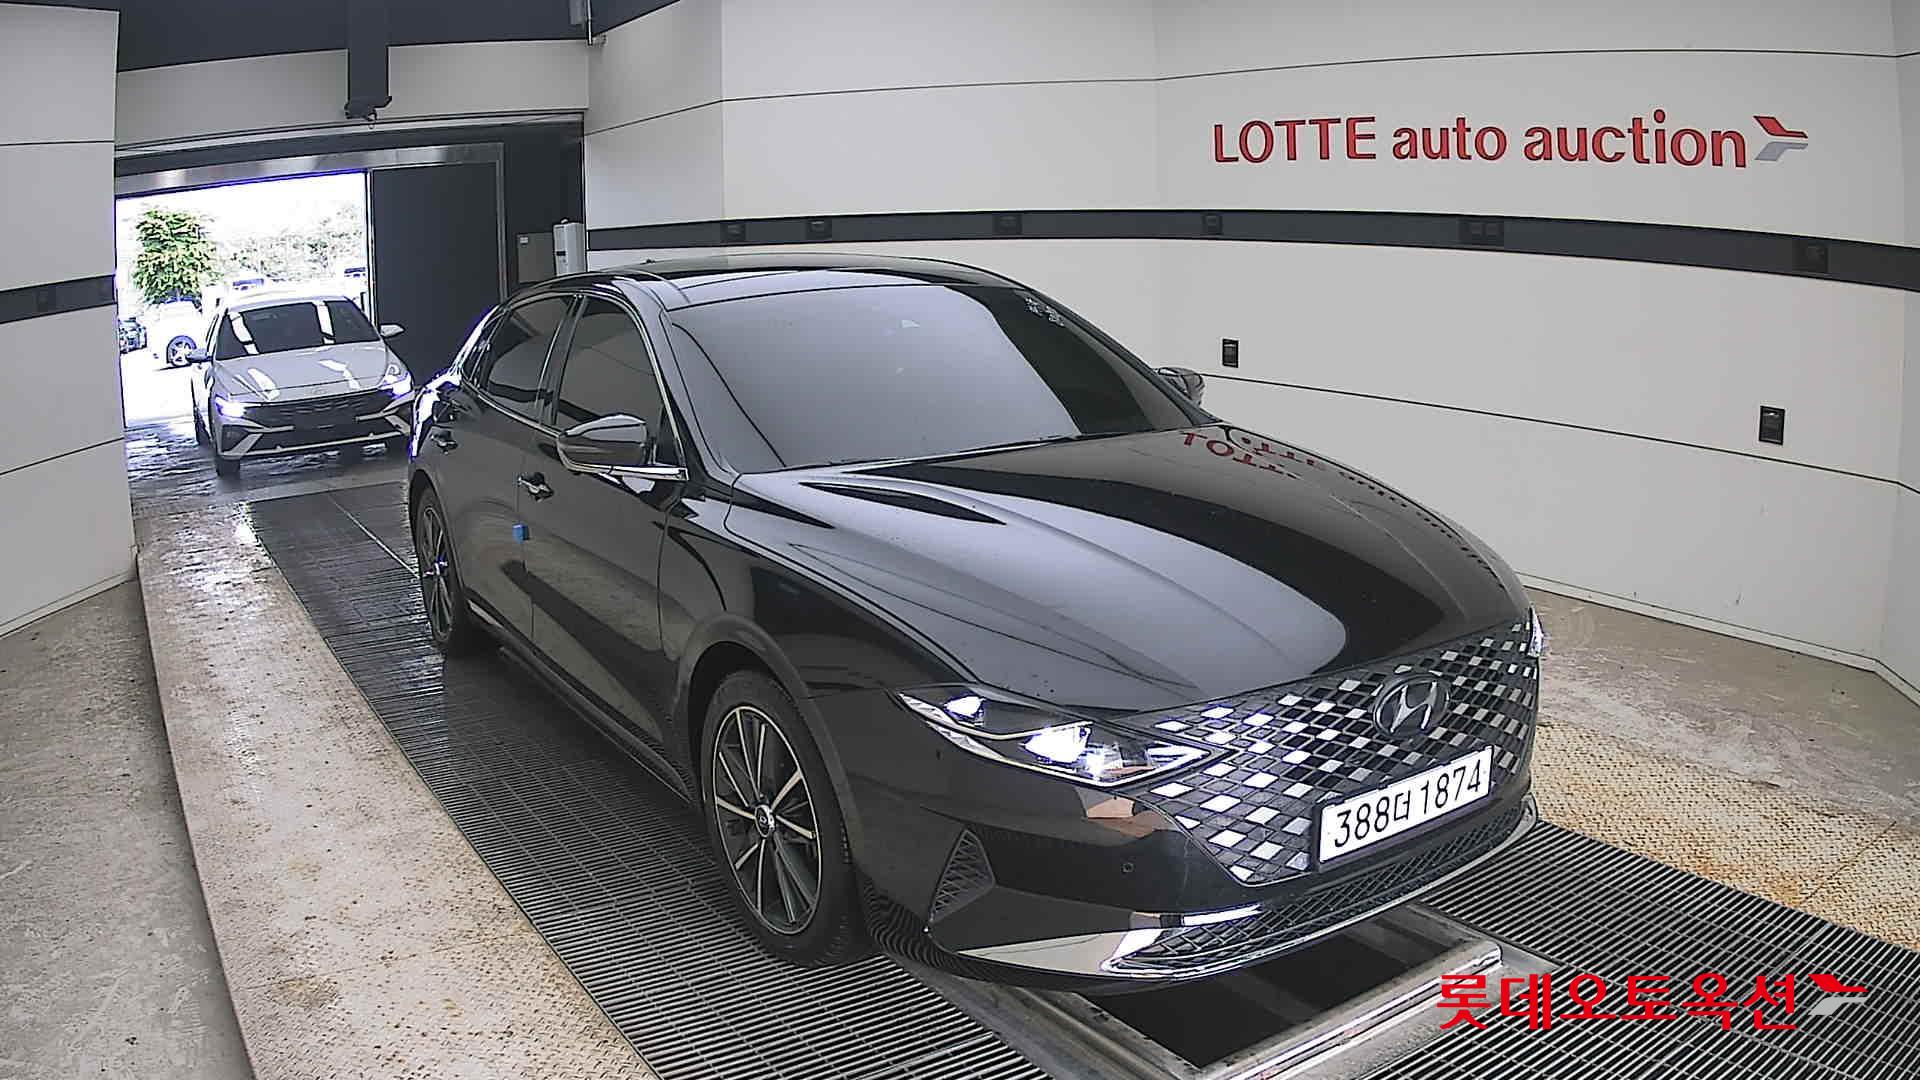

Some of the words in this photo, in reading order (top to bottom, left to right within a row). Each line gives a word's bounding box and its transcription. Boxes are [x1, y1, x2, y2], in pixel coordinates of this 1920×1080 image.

[1213, 116, 1377, 163] LOTTE
[1393, 117, 1509, 161] auto
[1522, 109, 1748, 168] auction
